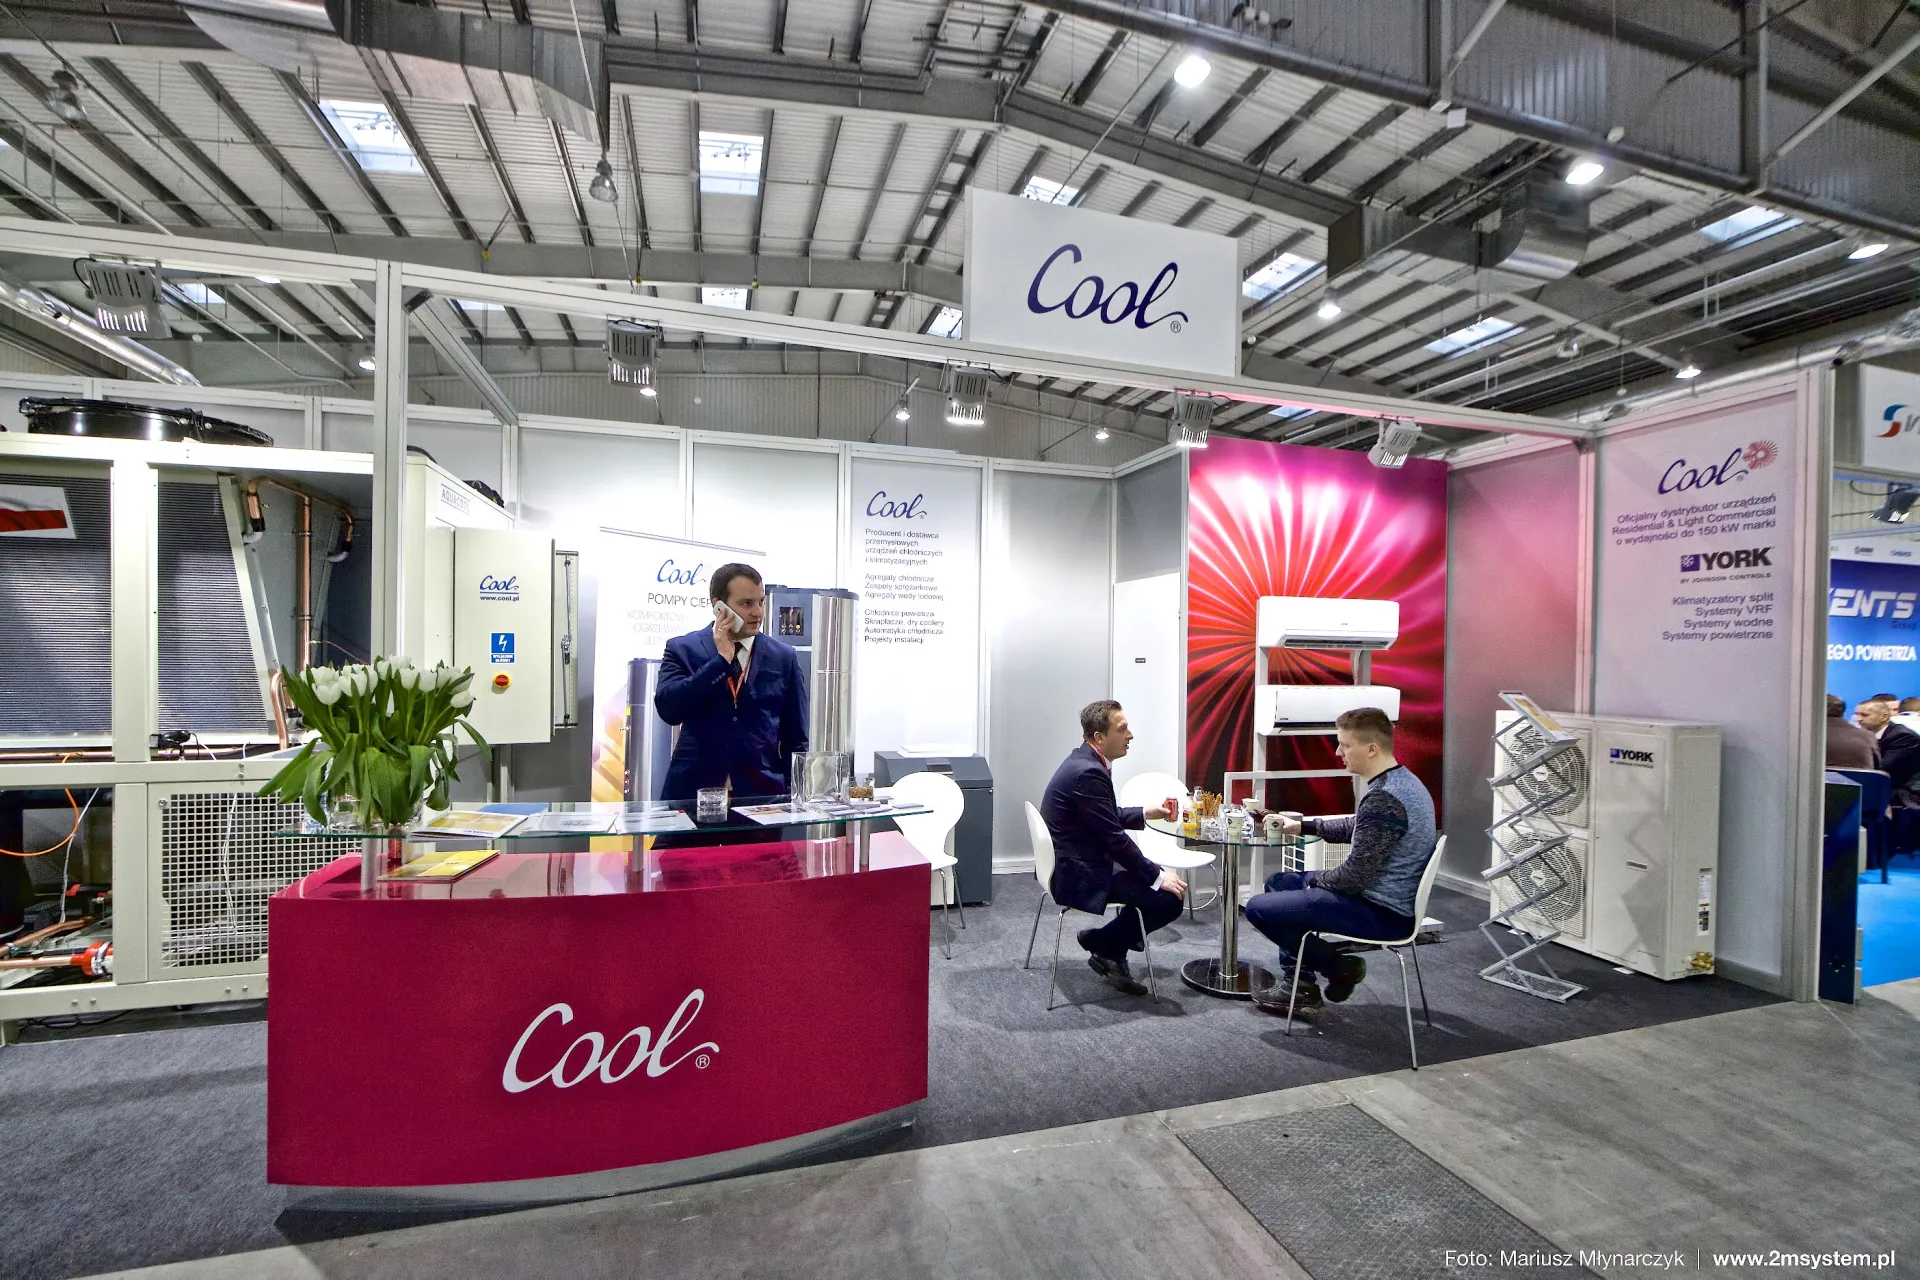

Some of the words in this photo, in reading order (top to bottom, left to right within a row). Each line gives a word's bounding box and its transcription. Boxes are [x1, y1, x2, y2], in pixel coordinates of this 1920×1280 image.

[1027, 243, 1188, 329] Cool
[1658, 448, 1749, 494] Cool
[866, 490, 927, 519] Cool
[1617, 511, 1659, 524] Oficjalny
[1660, 502, 1719, 520] dystrybutor
[1721, 492, 1777, 509] urządzeń
[1612, 522, 1665, 535] Residential
[1667, 520, 1675, 528] &
[1678, 516, 1704, 529] Light
[1707, 505, 1777, 523] Commercial
[865, 528, 901, 537] Producent
[907, 531, 940, 539] dostawca
[1625, 531, 1679, 545] wydajności
[1682, 529, 1695, 538] do
[1698, 525, 1718, 535] 150
[1721, 522, 1740, 533] kW
[1743, 518, 1777, 531] marki
[1701, 547, 1772, 571] YORK
[657, 559, 707, 586] Cool
[648, 593, 688, 606] POMPY
[1673, 595, 1747, 606] Klimatyzatory
[1749, 592, 1774, 603] split
[1829, 588, 1918, 619] ENTS
[1695, 605, 1744, 617] Systemy
[1747, 604, 1773, 614] VRF
[907, 619, 919, 627] dry
[1684, 618, 1732, 630] Systemy
[1734, 617, 1774, 627] wodne
[864, 635, 893, 644] Projekty
[1662, 631, 1708, 642] Systemy
[1710, 631, 1774, 642] powietrzne
[1855, 645, 1917, 661] POWIETRZA
[1621, 749, 1654, 762] YORK
[502, 988, 721, 1094] Cool
